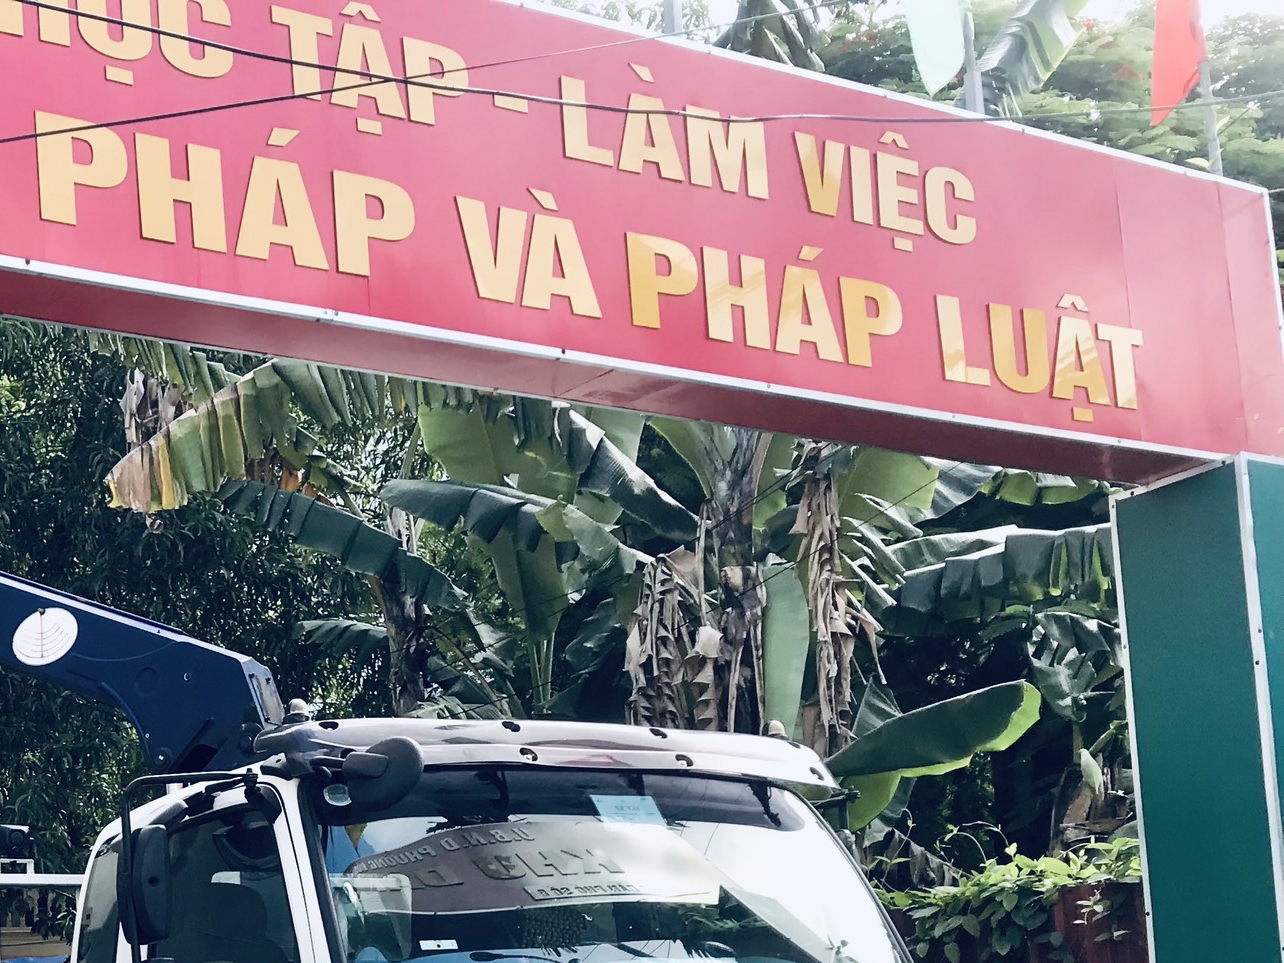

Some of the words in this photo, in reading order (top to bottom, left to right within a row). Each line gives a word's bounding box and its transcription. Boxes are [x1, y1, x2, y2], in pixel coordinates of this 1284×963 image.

[34, 109, 416, 277] PHÁP
[455, 187, 603, 319] VÀ
[624, 231, 903, 368] PHÁP
[935, 293, 1143, 423] LUẬT
[270, 0, 469, 136] TẬP
[559, 62, 770, 200] LÀM
[793, 130, 977, 253] VIỆC
